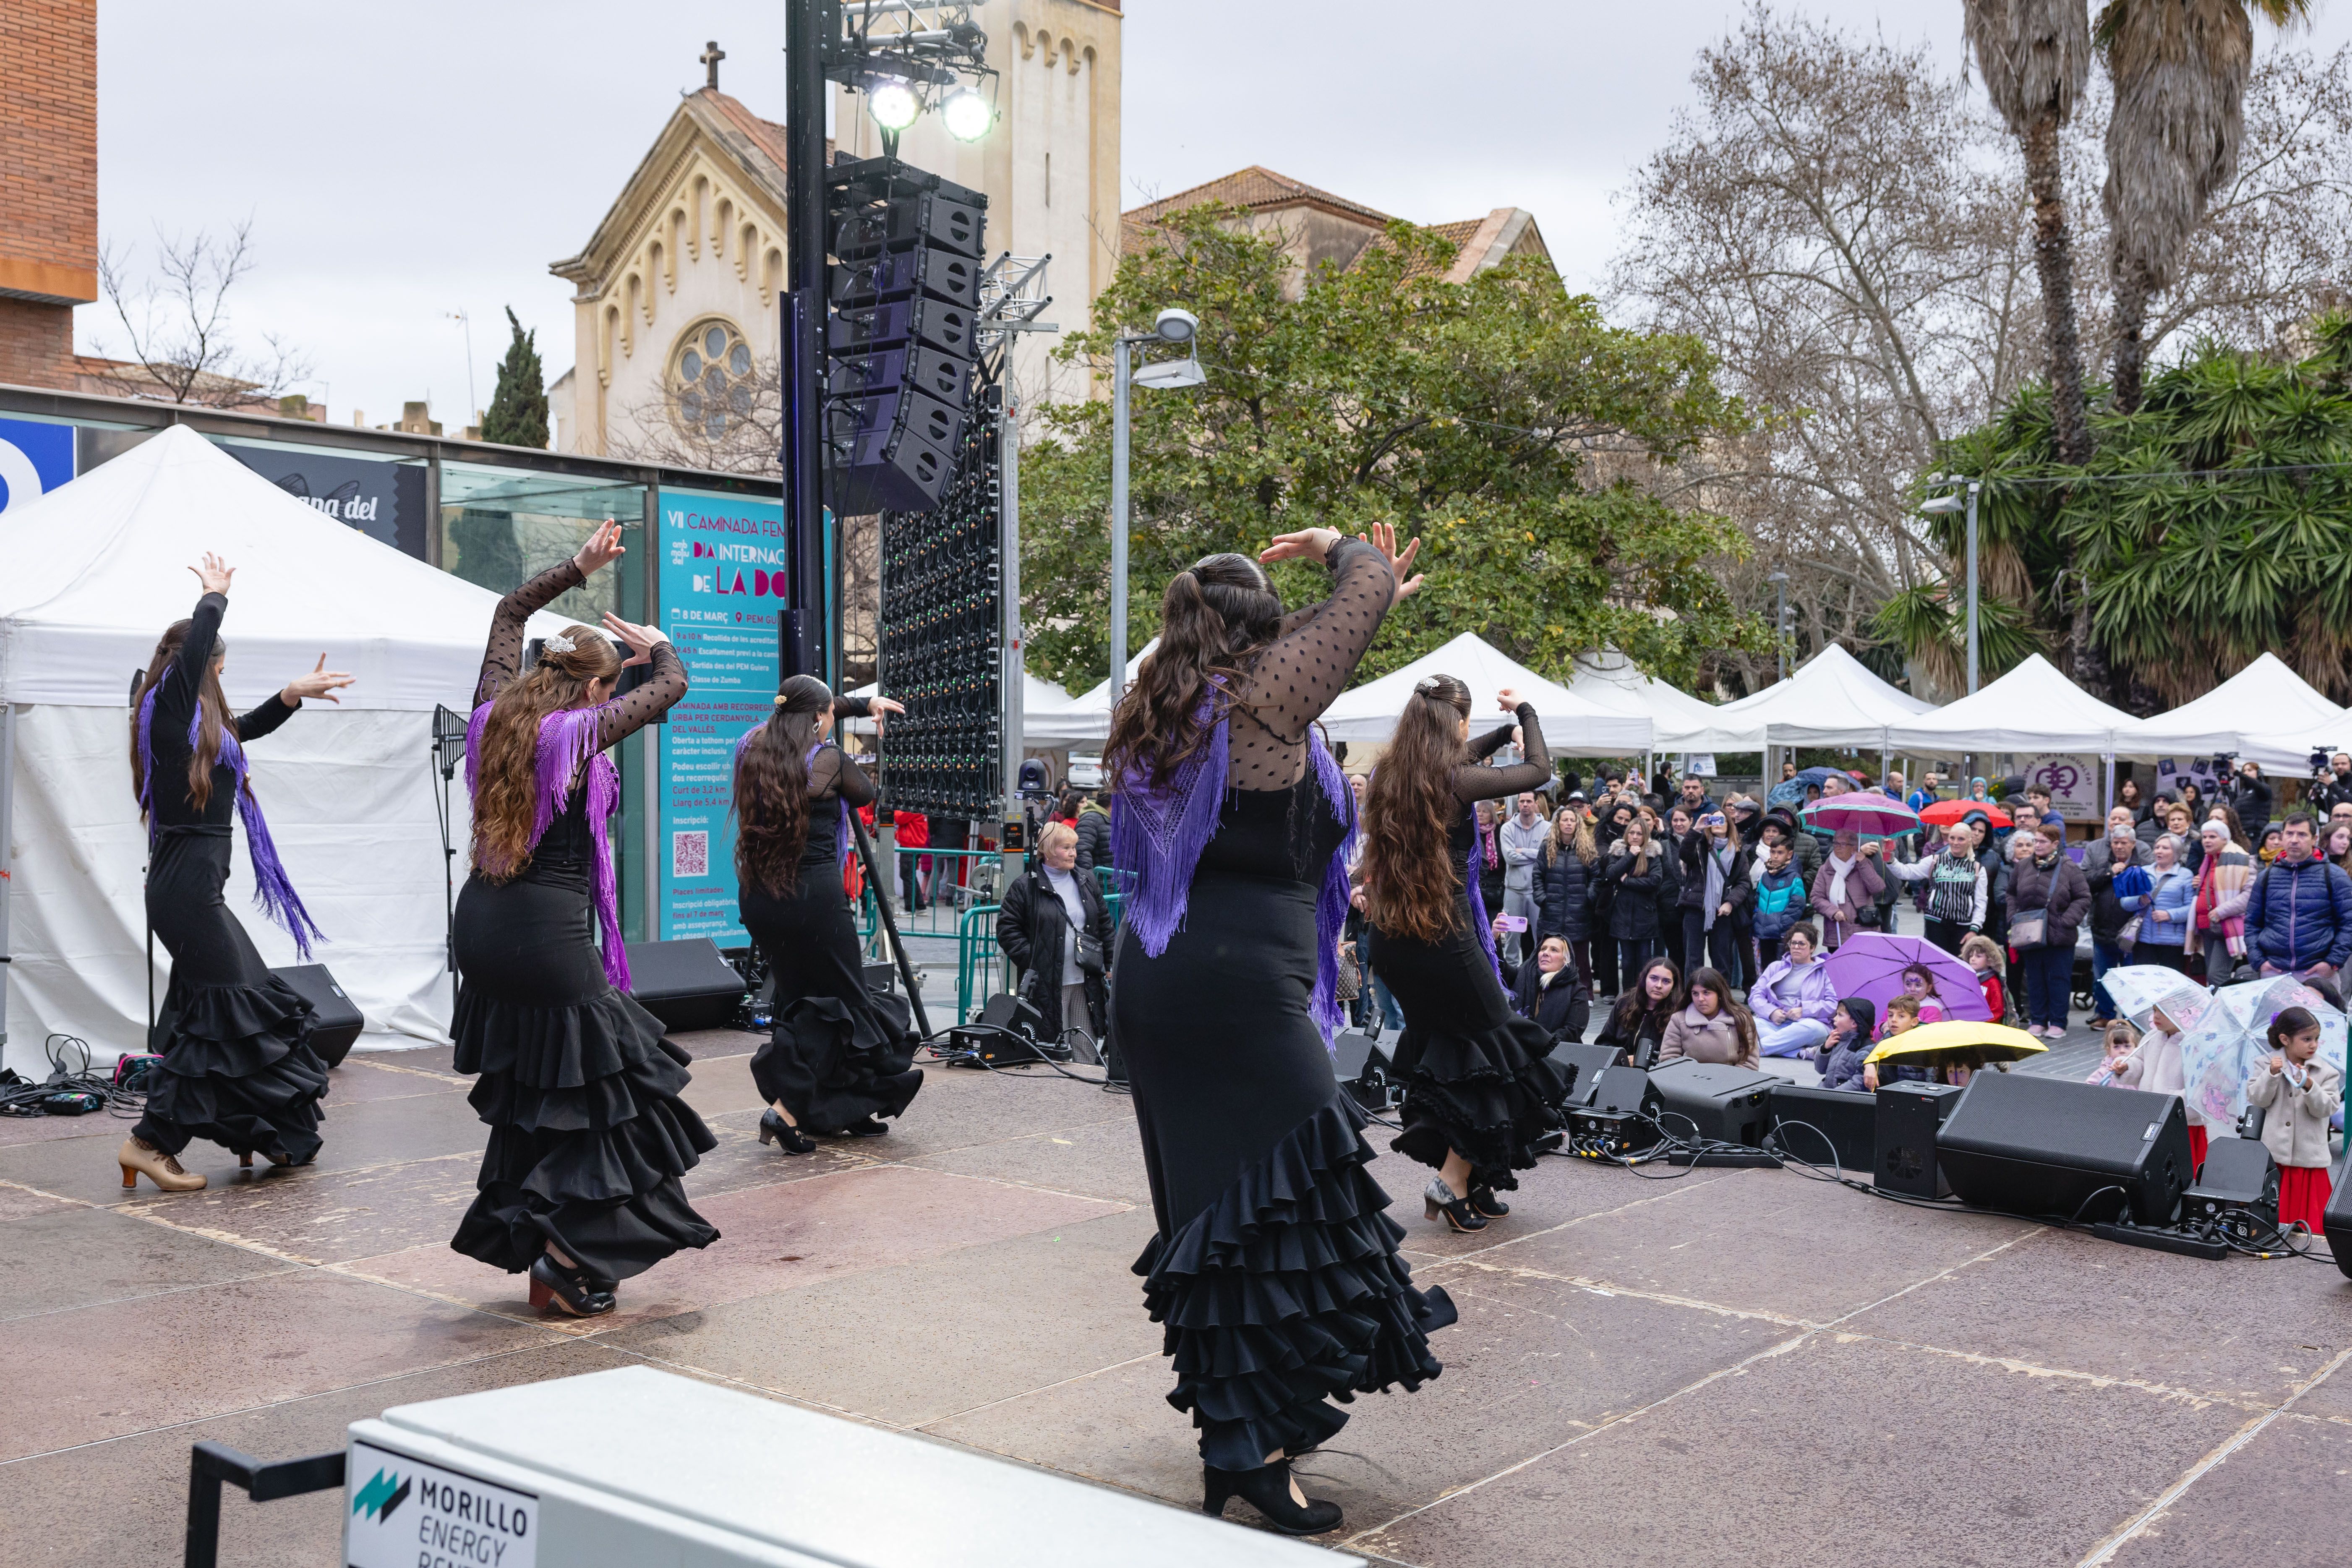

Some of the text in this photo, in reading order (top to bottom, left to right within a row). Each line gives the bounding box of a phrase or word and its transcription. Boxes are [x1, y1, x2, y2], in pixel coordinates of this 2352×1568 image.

[344, 495, 378, 521] del
[668, 510, 683, 528] VII
[687, 513, 759, 535] CAMINADA
[694, 541, 716, 559] DIA
[693, 574, 711, 592] DE
[716, 566, 747, 595] LA
[683, 611, 688, 619] 8
[690, 611, 702, 620] DE
[704, 612, 728, 624] MARÇ
[747, 614, 763, 624] PEM
[673, 786, 689, 794] Curt
[673, 799, 692, 808] Llarg
[673, 816, 708, 825] Inscripció:
[673, 900, 703, 909] Inscripció
[420, 1477, 527, 1537] MORILLO
[419, 1515, 507, 1567] ENERGY
